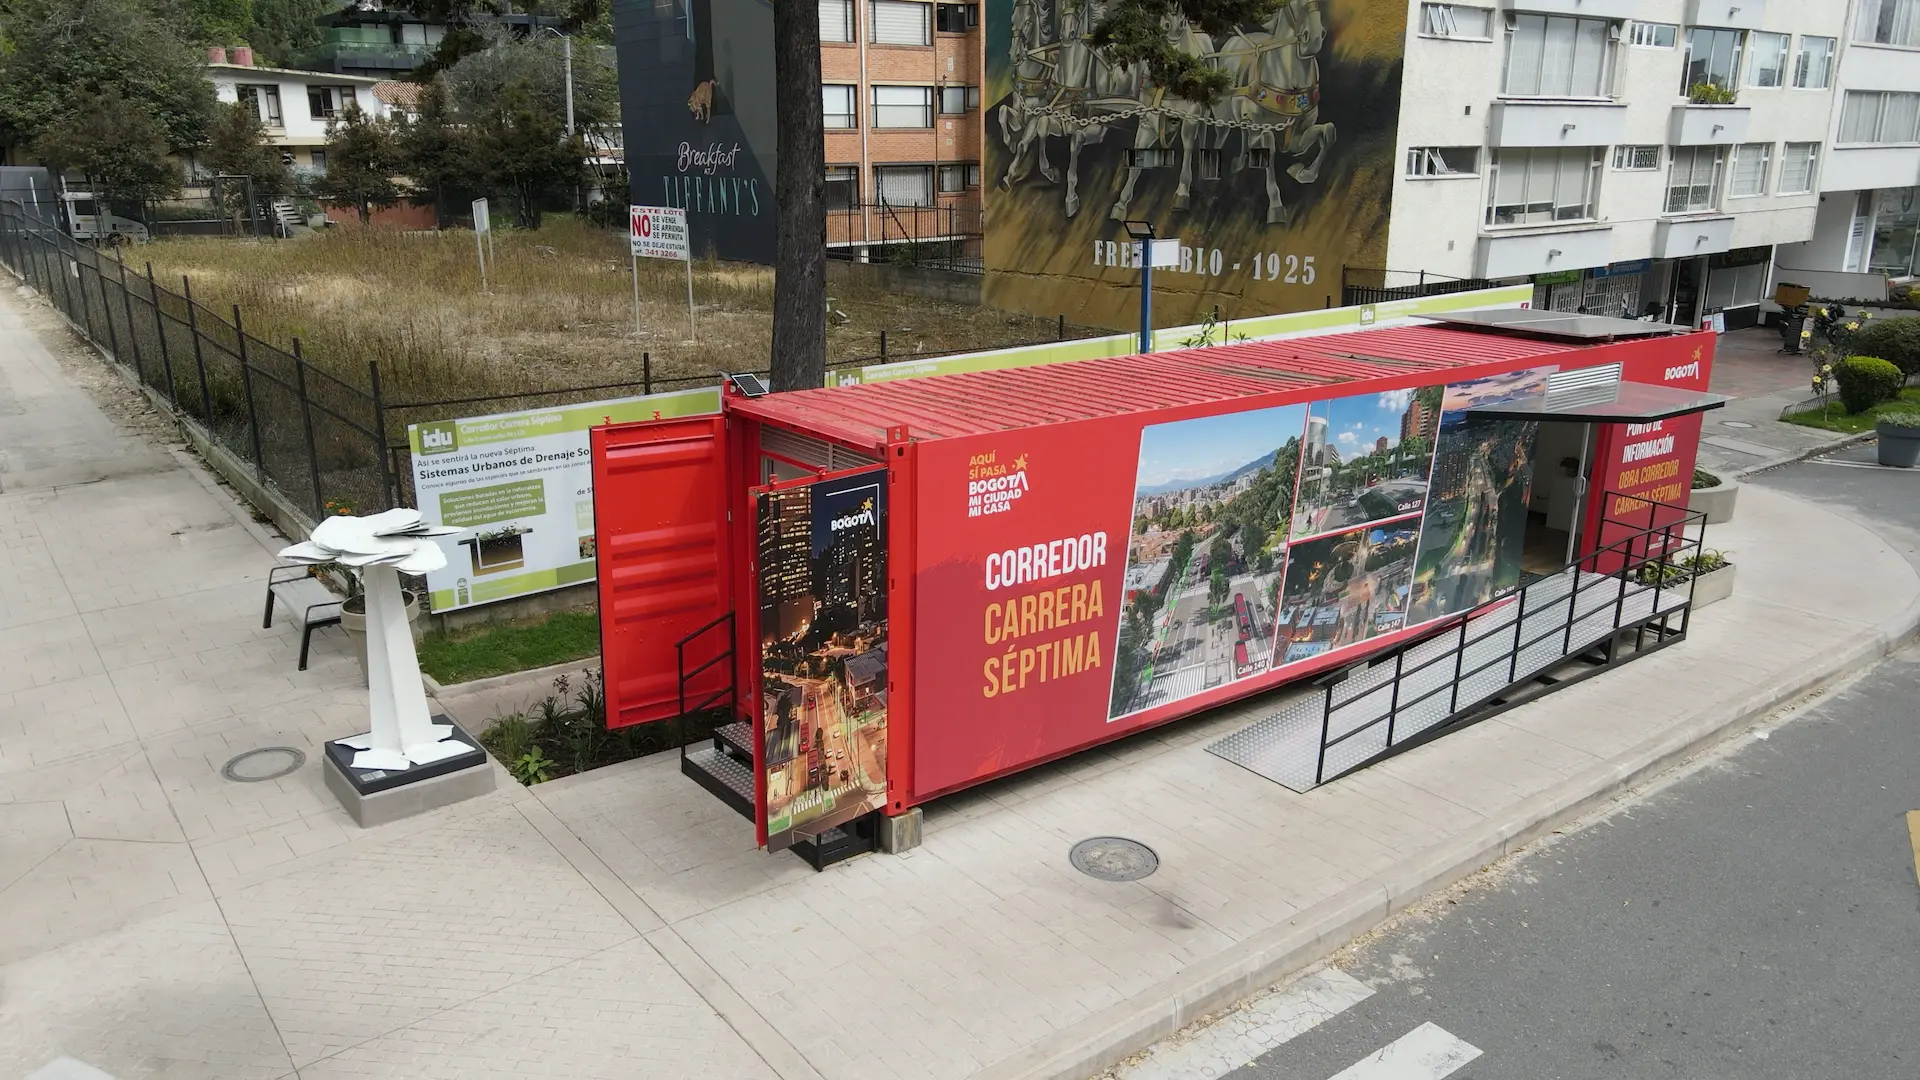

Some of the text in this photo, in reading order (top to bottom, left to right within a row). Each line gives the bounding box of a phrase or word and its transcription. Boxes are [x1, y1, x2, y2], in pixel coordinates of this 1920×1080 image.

[678, 142, 740, 175] Breakfast
[663, 176, 758, 216] TIFFANY'S
[632, 214, 651, 238] NO
[661, 216, 676, 224] VENDE
[661, 224, 684, 232] ARRIENDA
[661, 232, 684, 241] PERMUTA
[1094, 240, 1131, 268] FRE
[1252, 252, 1316, 286] 1925
[460, 414, 562, 434] Corredor Carrera Séptima
[1652, 420, 1663, 431] DE
[422, 428, 452, 448] idu
[442, 455, 469, 463] sentirá
[480, 451, 502, 459] nueva
[1622, 433, 1674, 463] INFORMACIÓN
[420, 466, 469, 479] Sistemas
[472, 459, 518, 472] Urbanos
[520, 456, 533, 465] de
[536, 450, 575, 463] Drenaje
[969, 450, 996, 466] AQUÍ
[969, 464, 1006, 480] SÍ PASA
[1618, 459, 1679, 489] OBRA CORREDOR
[443, 494, 474, 504] Soluciones
[512, 484, 541, 492] naturaleza
[466, 499, 489, 508] reducen
[968, 488, 1022, 507] MI CIUDAD
[1614, 482, 1682, 515] CARRERA SÉPTIMA
[443, 510, 472, 519] previenen
[473, 504, 509, 512] inundaciones
[968, 501, 1011, 517] MI CASA
[1398, 502, 1411, 511] Calle
[985, 531, 1107, 591] CORREDOR
[984, 580, 1103, 645] CARRERA
[1378, 622, 1390, 631] Calle
[983, 630, 1101, 698] SÉPTIMA
[1238, 660, 1265, 674] Calle 140
